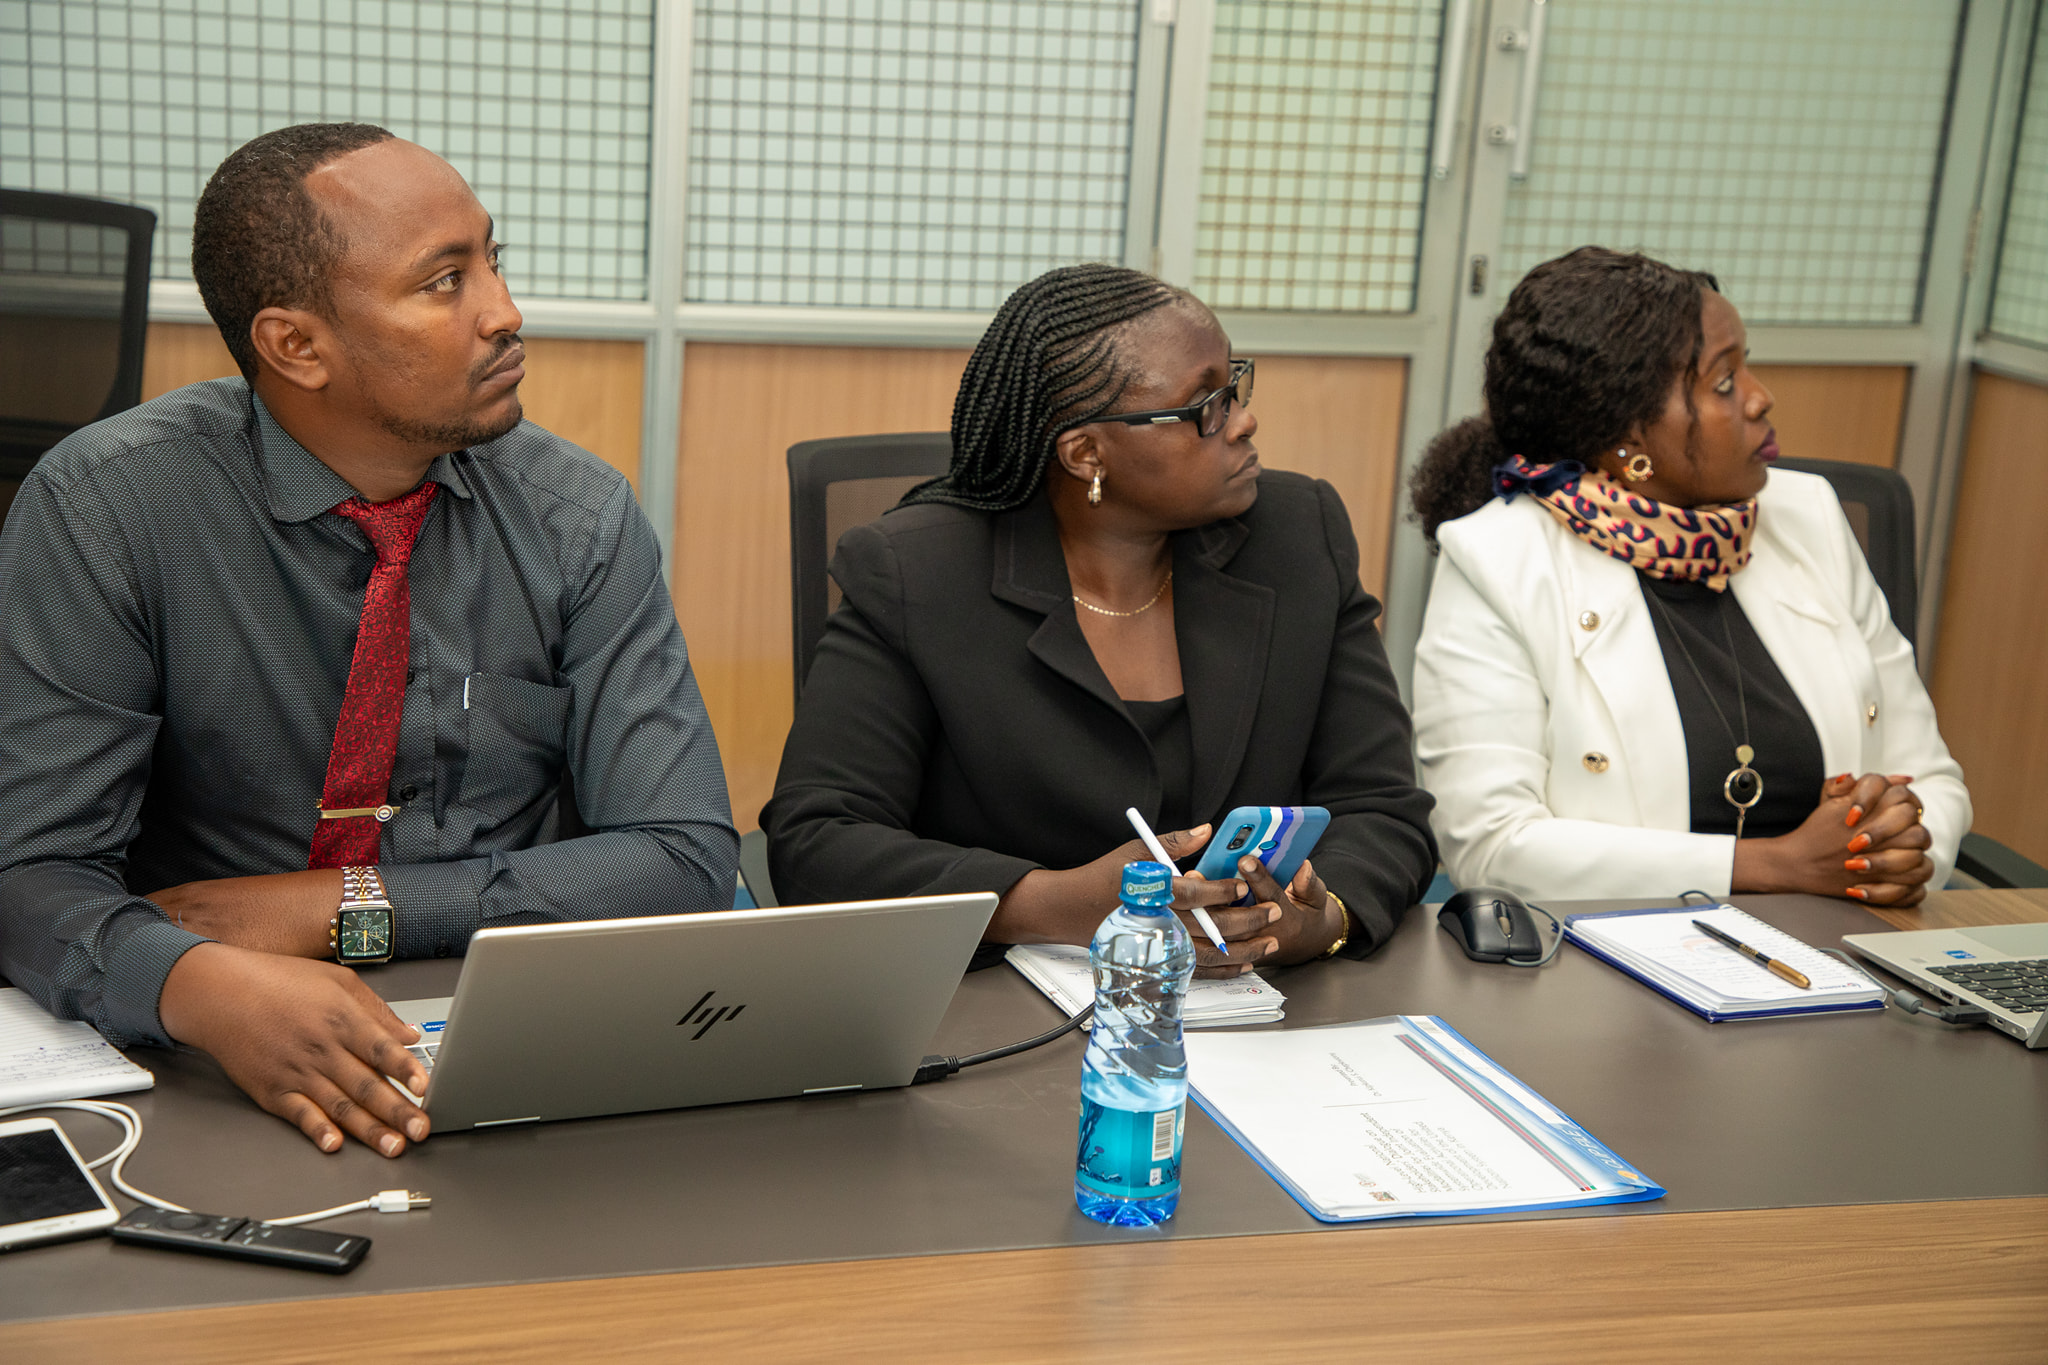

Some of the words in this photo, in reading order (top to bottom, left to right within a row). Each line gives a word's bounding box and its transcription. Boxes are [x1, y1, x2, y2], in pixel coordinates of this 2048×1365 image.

[1127, 881, 1165, 895] QUENCHER
[676, 990, 746, 1041] hp
[1358, 1112, 1399, 1142] Independent
[1412, 1121, 1439, 1138] United
[1372, 1137, 1404, 1159] Dialogue
[1393, 1143, 1415, 1155] Joint
[1399, 1135, 1435, 1160] Evaluation
[1417, 1137, 1447, 1158] Activities
[1561, 1129, 1598, 1149] FILE
[1363, 1144, 1396, 1166] National
[1588, 1148, 1623, 1169] CLIP
[1419, 1165, 1456, 1192] Modalities
[1452, 1155, 1498, 1189] Development
